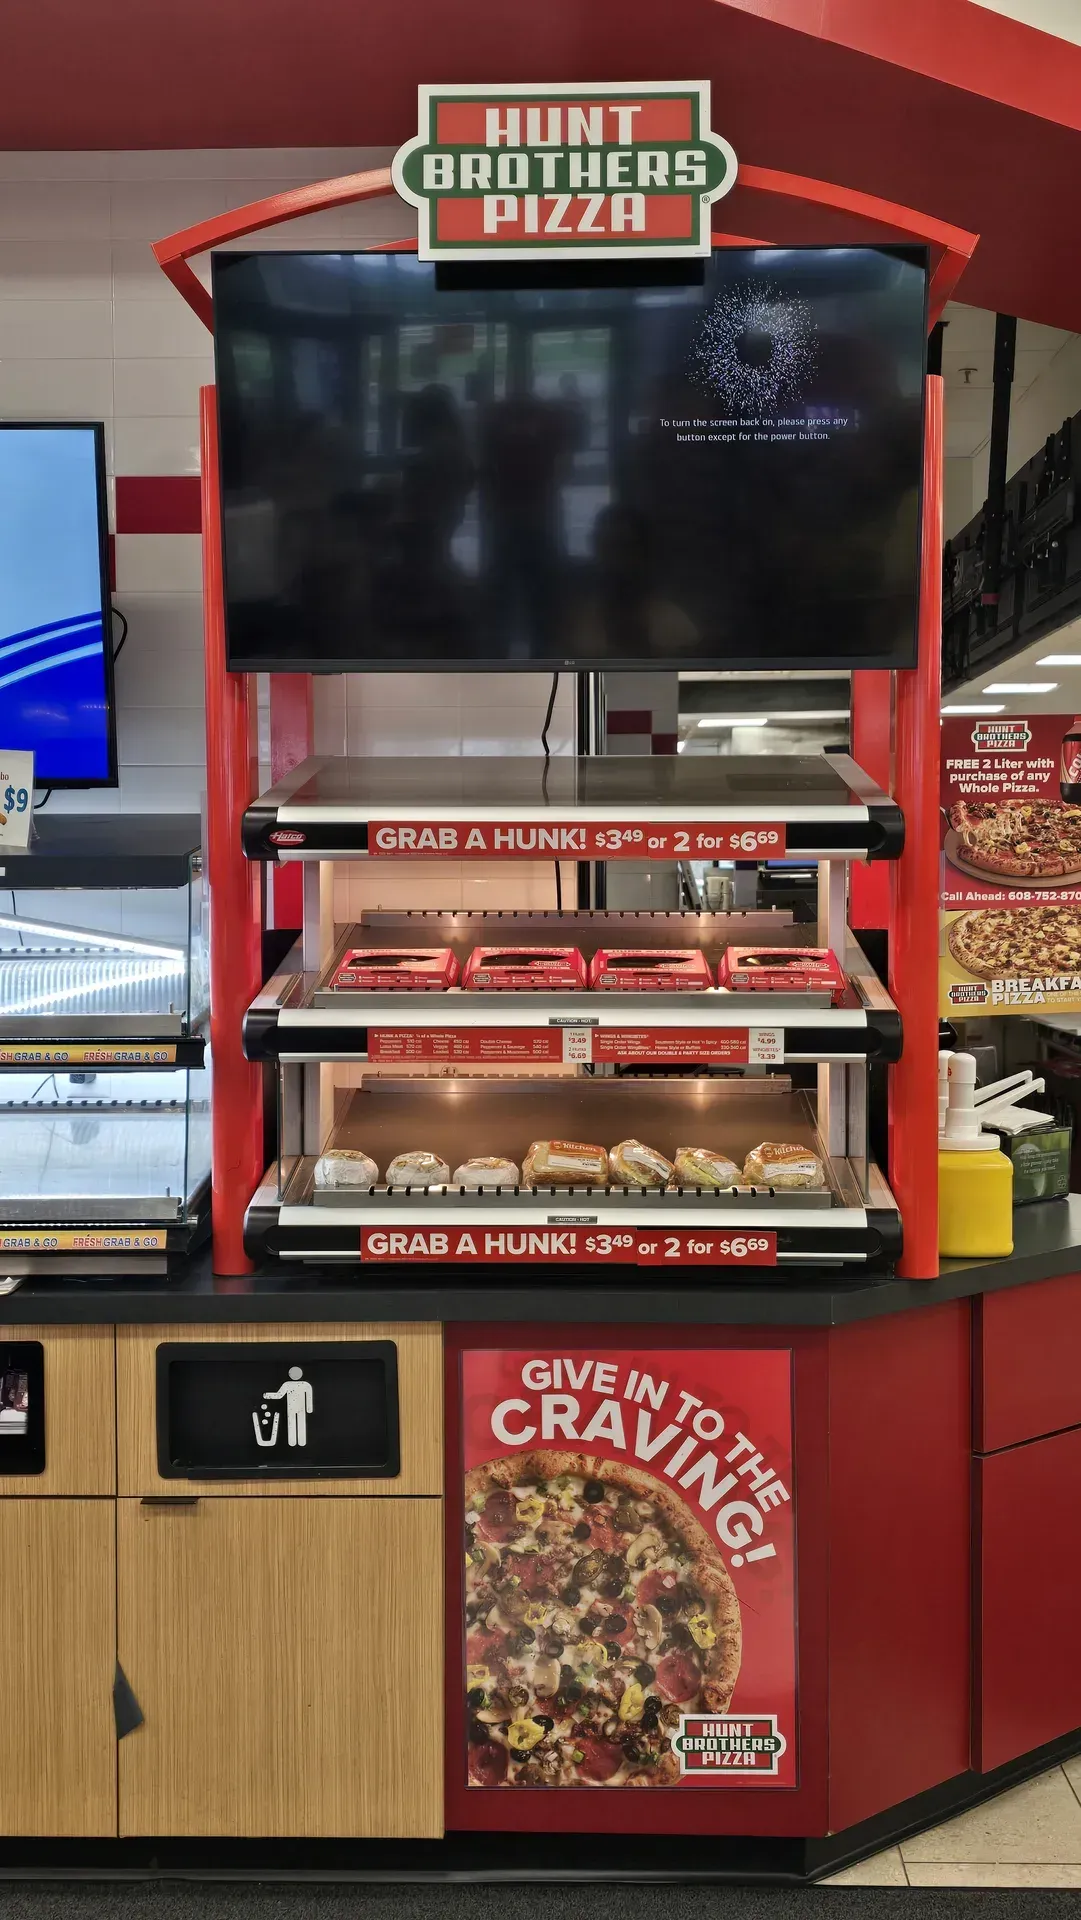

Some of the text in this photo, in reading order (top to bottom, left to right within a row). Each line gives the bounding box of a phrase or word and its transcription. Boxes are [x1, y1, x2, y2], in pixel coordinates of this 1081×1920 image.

[486, 106, 641, 146] HUNT
[423, 150, 706, 189] BROTHERS
[484, 192, 645, 233] PIZZA
[740, 418, 760, 426] back
[762, 419, 775, 427] on,
[778, 418, 805, 427] please
[808, 418, 830, 426] press
[833, 418, 848, 426] any
[676, 432, 830, 442] button except for the power button.
[946, 758, 1054, 769] FREE 2 Liter with
[950, 770, 1050, 783] purchase of any
[959, 782, 1039, 792] Whole Pizza.
[4, 785, 28, 814] $9
[270, 832, 304, 841] Hatco
[376, 828, 458, 850] GRAB
[464, 828, 486, 850] A
[494, 828, 586, 850] HUNK!
[648, 836, 667, 849] or
[674, 831, 690, 851] 2
[696, 833, 723, 849] for
[941, 892, 962, 900] Call
[966, 892, 1005, 900] Ahead:
[992, 992, 1046, 1005] PIZZA
[15, 1052, 41, 1060] GRAB
[45, 1052, 50, 1060] &
[54, 1052, 69, 1060] GO
[114, 1052, 140, 1060] GRAB
[143, 1052, 150, 1060] &
[154, 1052, 168, 1060] GO
[4, 1238, 58, 1247] GRAB & GO
[104, 1238, 130, 1246] GRAB
[134, 1238, 140, 1246] &
[143, 1237, 157, 1246] GO
[367, 1232, 448, 1255] GRAB
[455, 1233, 478, 1254] A
[485, 1232, 576, 1255] HUNK!
[638, 1242, 658, 1254] or
[664, 1238, 680, 1257] 2
[687, 1239, 713, 1254] for
[522, 1359, 790, 1513] GIVE IN TO THE
[491, 1394, 776, 1568] CRAVING!
[703, 1724, 754, 1737] HUNT
[682, 1738, 775, 1751] BROTHERS
[702, 1752, 755, 1765] PIZZA
